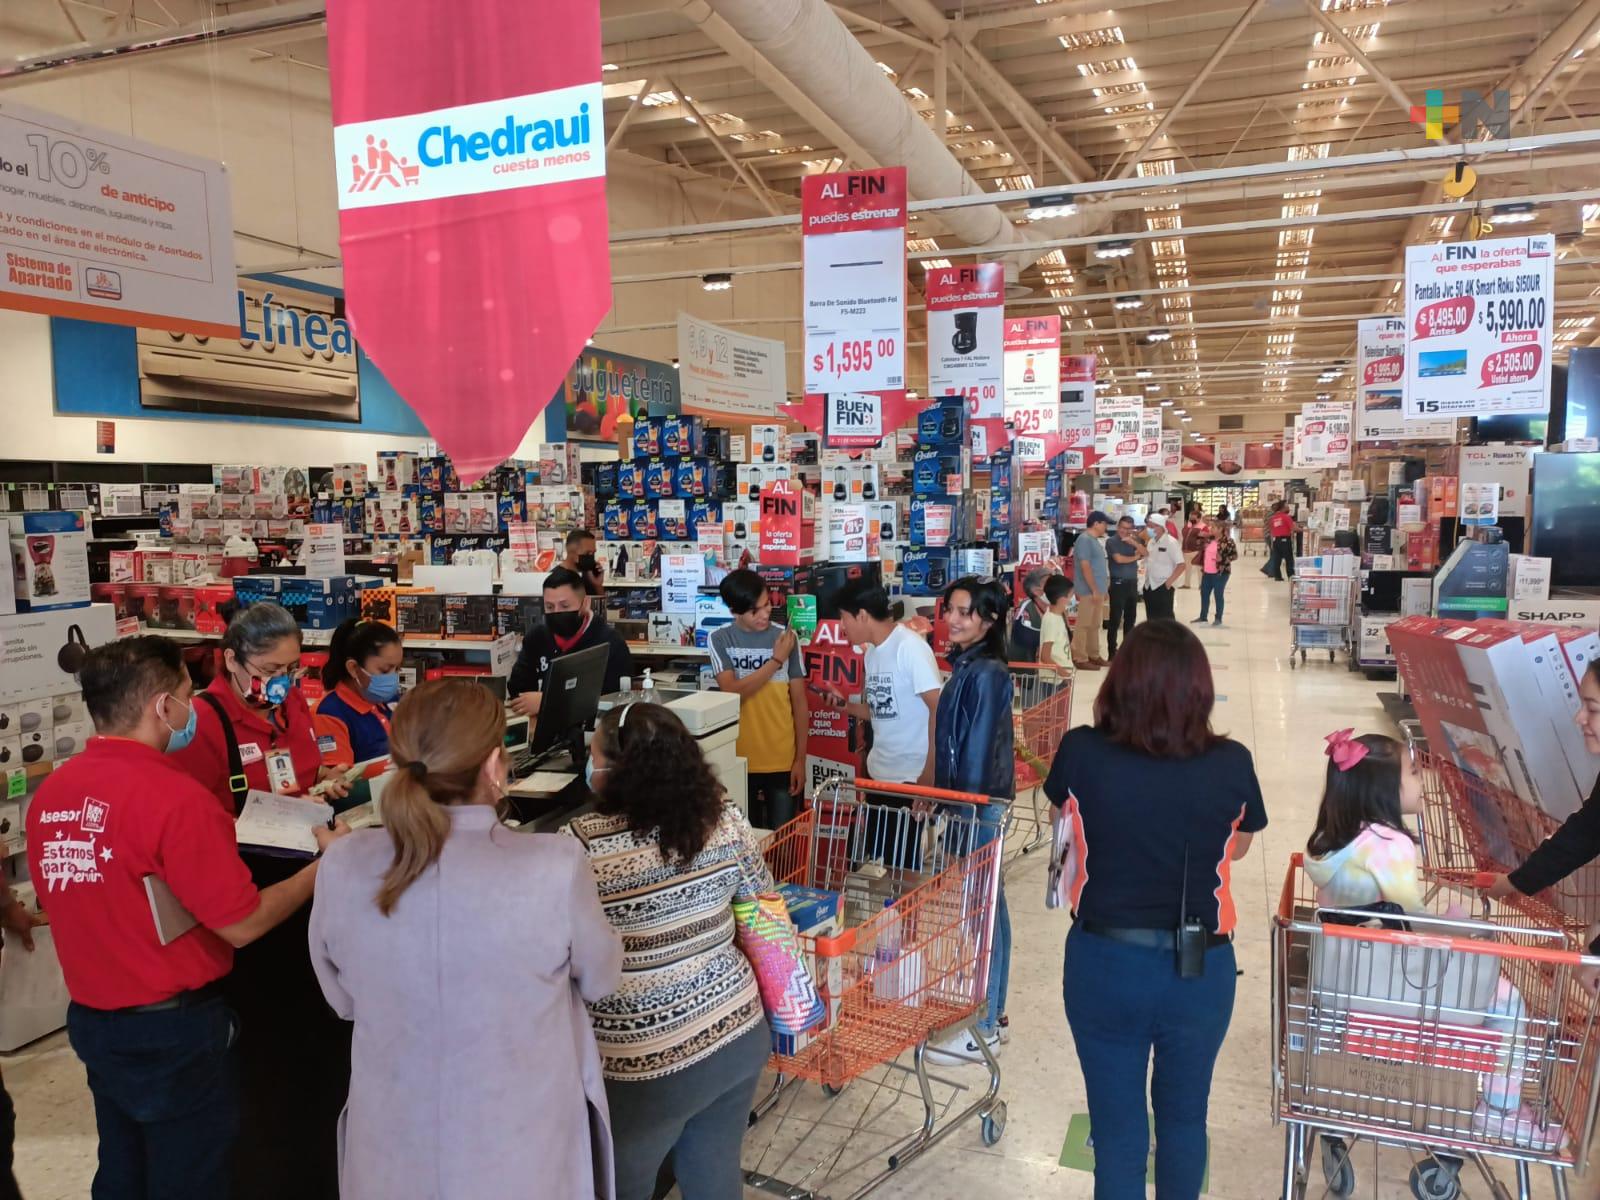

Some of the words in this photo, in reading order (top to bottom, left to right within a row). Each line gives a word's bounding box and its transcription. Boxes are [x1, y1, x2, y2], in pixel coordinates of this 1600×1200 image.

[418, 102, 590, 168] Chedraui
[493, 159, 540, 175] cuesta
[543, 150, 591, 168] menos
[16, 163, 29, 177] el
[821, 182, 844, 200] AL
[847, 175, 885, 196] FIN
[101, 184, 119, 199] de
[122, 191, 176, 212] anticipo
[809, 211, 849, 227] puedes
[851, 207, 900, 221] estrenar
[6, 212, 13, 222] y
[16, 215, 78, 235] condiciones
[80, 228, 93, 238] en
[95, 231, 104, 240] el
[106, 233, 142, 248] módulo
[144, 241, 157, 252] de
[158, 244, 204, 261] Apartados
[26, 230, 39, 240] en
[42, 233, 52, 243] el
[54, 236, 77, 248] área
[79, 240, 92, 250] de
[94, 243, 149, 262] electrónica.
[1445, 246, 1477, 261] FIN
[1480, 249, 1490, 258] la
[1491, 246, 1527, 258] oferta
[6, 252, 52, 275] Sistema
[54, 258, 72, 277] de
[1436, 263, 1457, 275] que
[1461, 258, 1522, 273] esperabas
[9, 266, 73, 292] Apartado
[939, 273, 957, 286] AL
[1414, 282, 1441, 301] Pantalla
[1442, 281, 1454, 298] Jvc
[1455, 280, 1463, 298] 50
[1464, 280, 1474, 297] 4K
[1475, 278, 1496, 296] Smart
[1498, 276, 1514, 294] Roku
[810, 299, 826, 307] Barra
[931, 294, 961, 305] puedes
[962, 290, 999, 301] estrenar
[238, 289, 353, 355] Línea
[1486, 297, 1545, 339] 5,990.00
[1011, 323, 1024, 333] AL
[1026, 320, 1048, 331] FIN
[1386, 320, 1406, 331] FIN
[1429, 327, 1457, 337] Antes
[1505, 332, 1532, 343] Ahora
[878, 337, 895, 358] 00
[1496, 351, 1534, 377] 2,505.00
[572, 357, 673, 405] Juguetería
[983, 385, 996, 399] 00
[837, 400, 873, 413] BUEN
[920, 401, 941, 413] ster
[1416, 400, 1439, 413] 15
[1043, 408, 1053, 420] 00
[1364, 428, 1380, 436] 15
[1018, 440, 1040, 449] BUEN
[914, 450, 939, 462] Oster
[772, 481, 794, 495] AL
[763, 496, 797, 516] FIN
[766, 530, 772, 538] la
[773, 530, 793, 538] oferta
[310, 544, 316, 554] 3
[762, 543, 797, 551] esperabas
[772, 538, 786, 547] que
[904, 551, 928, 563] Oster
[1022, 553, 1042, 565] AL
[666, 577, 673, 588] 4
[667, 592, 674, 602] 3
[815, 623, 849, 646] AL
[1365, 627, 1379, 636] 32
[806, 651, 857, 684] FIN
[814, 710, 841, 720] oferta
[813, 720, 832, 729] que
[39, 809, 81, 824] Asesor
